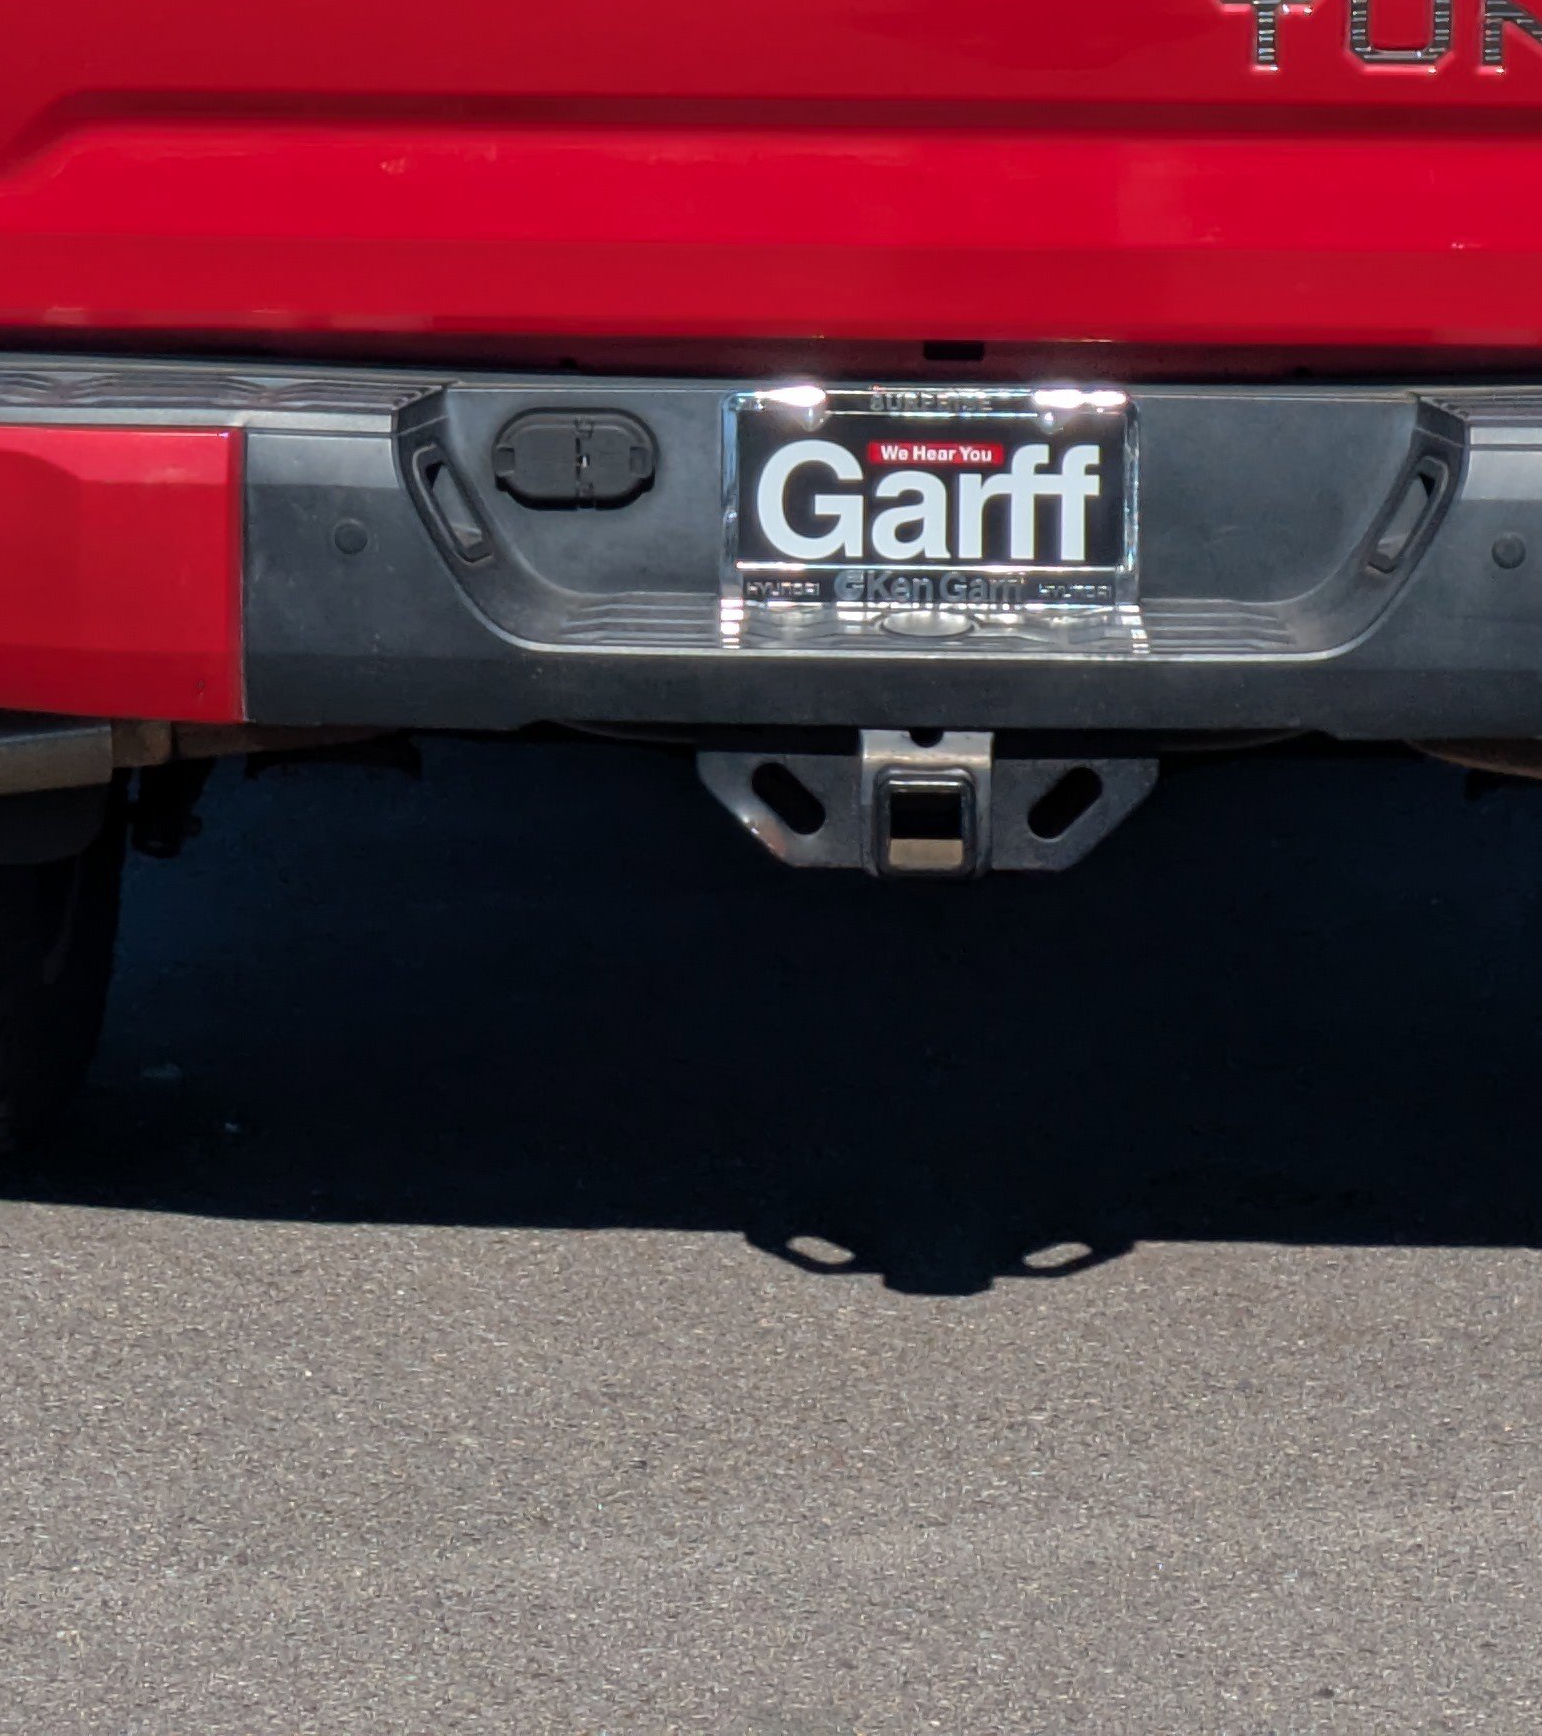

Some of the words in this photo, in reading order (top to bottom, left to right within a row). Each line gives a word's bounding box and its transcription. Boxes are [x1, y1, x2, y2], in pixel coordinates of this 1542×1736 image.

[880, 444, 909, 461] We
[912, 444, 957, 461] Hear
[959, 445, 992, 462] You
[757, 439, 1101, 561] Garff
[867, 569, 934, 602] Ken
